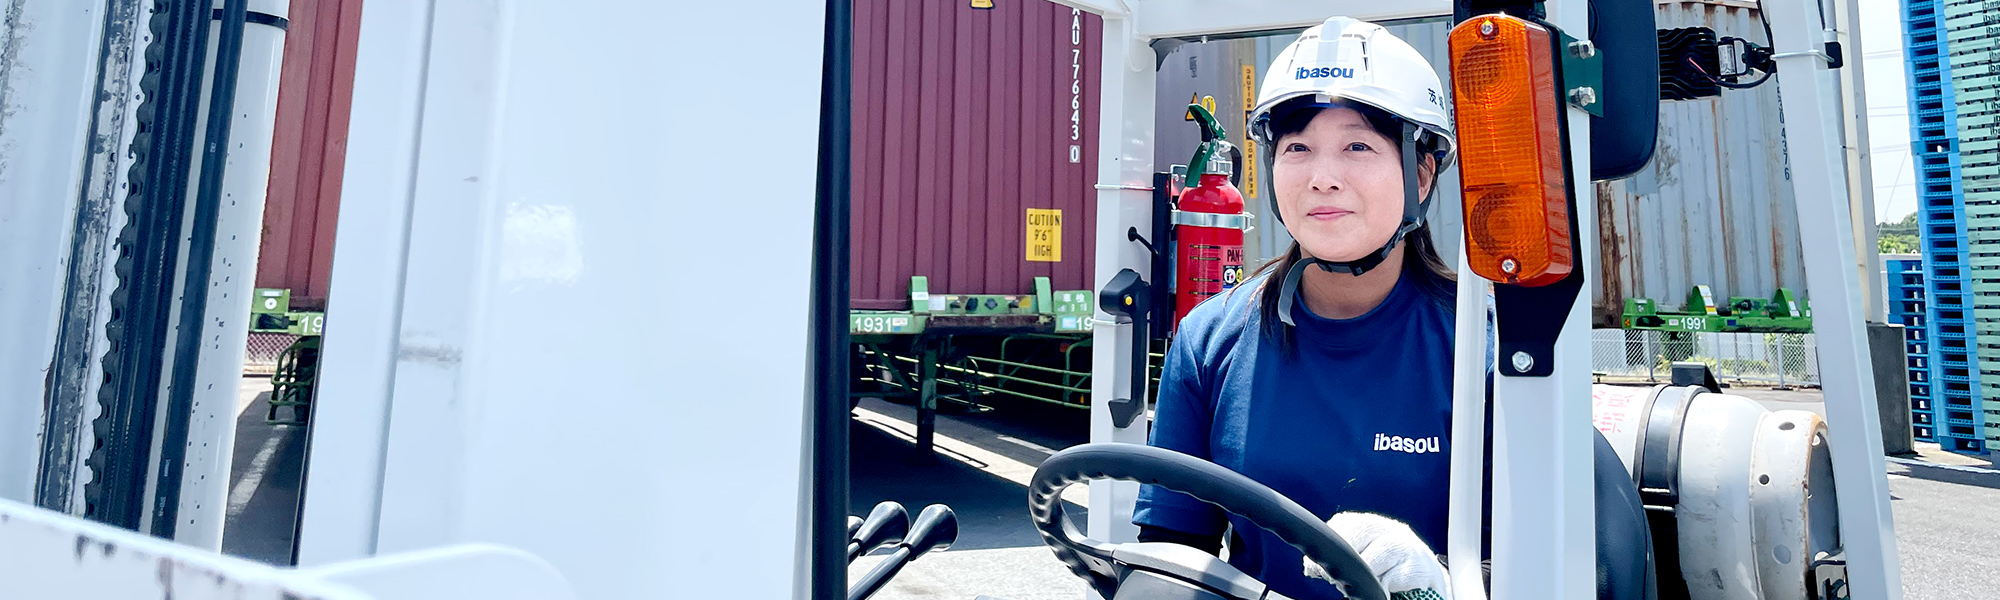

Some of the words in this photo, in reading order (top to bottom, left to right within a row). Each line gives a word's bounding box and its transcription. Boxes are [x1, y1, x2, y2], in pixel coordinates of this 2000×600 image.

[1295, 66, 1354, 80] ibasou
[1071, 49, 1080, 140] 776643
[1071, 146, 1079, 163] 0
[855, 317, 892, 332] 1931
[1680, 317, 1707, 330] 1991
[1374, 433, 1440, 453] ibasou
